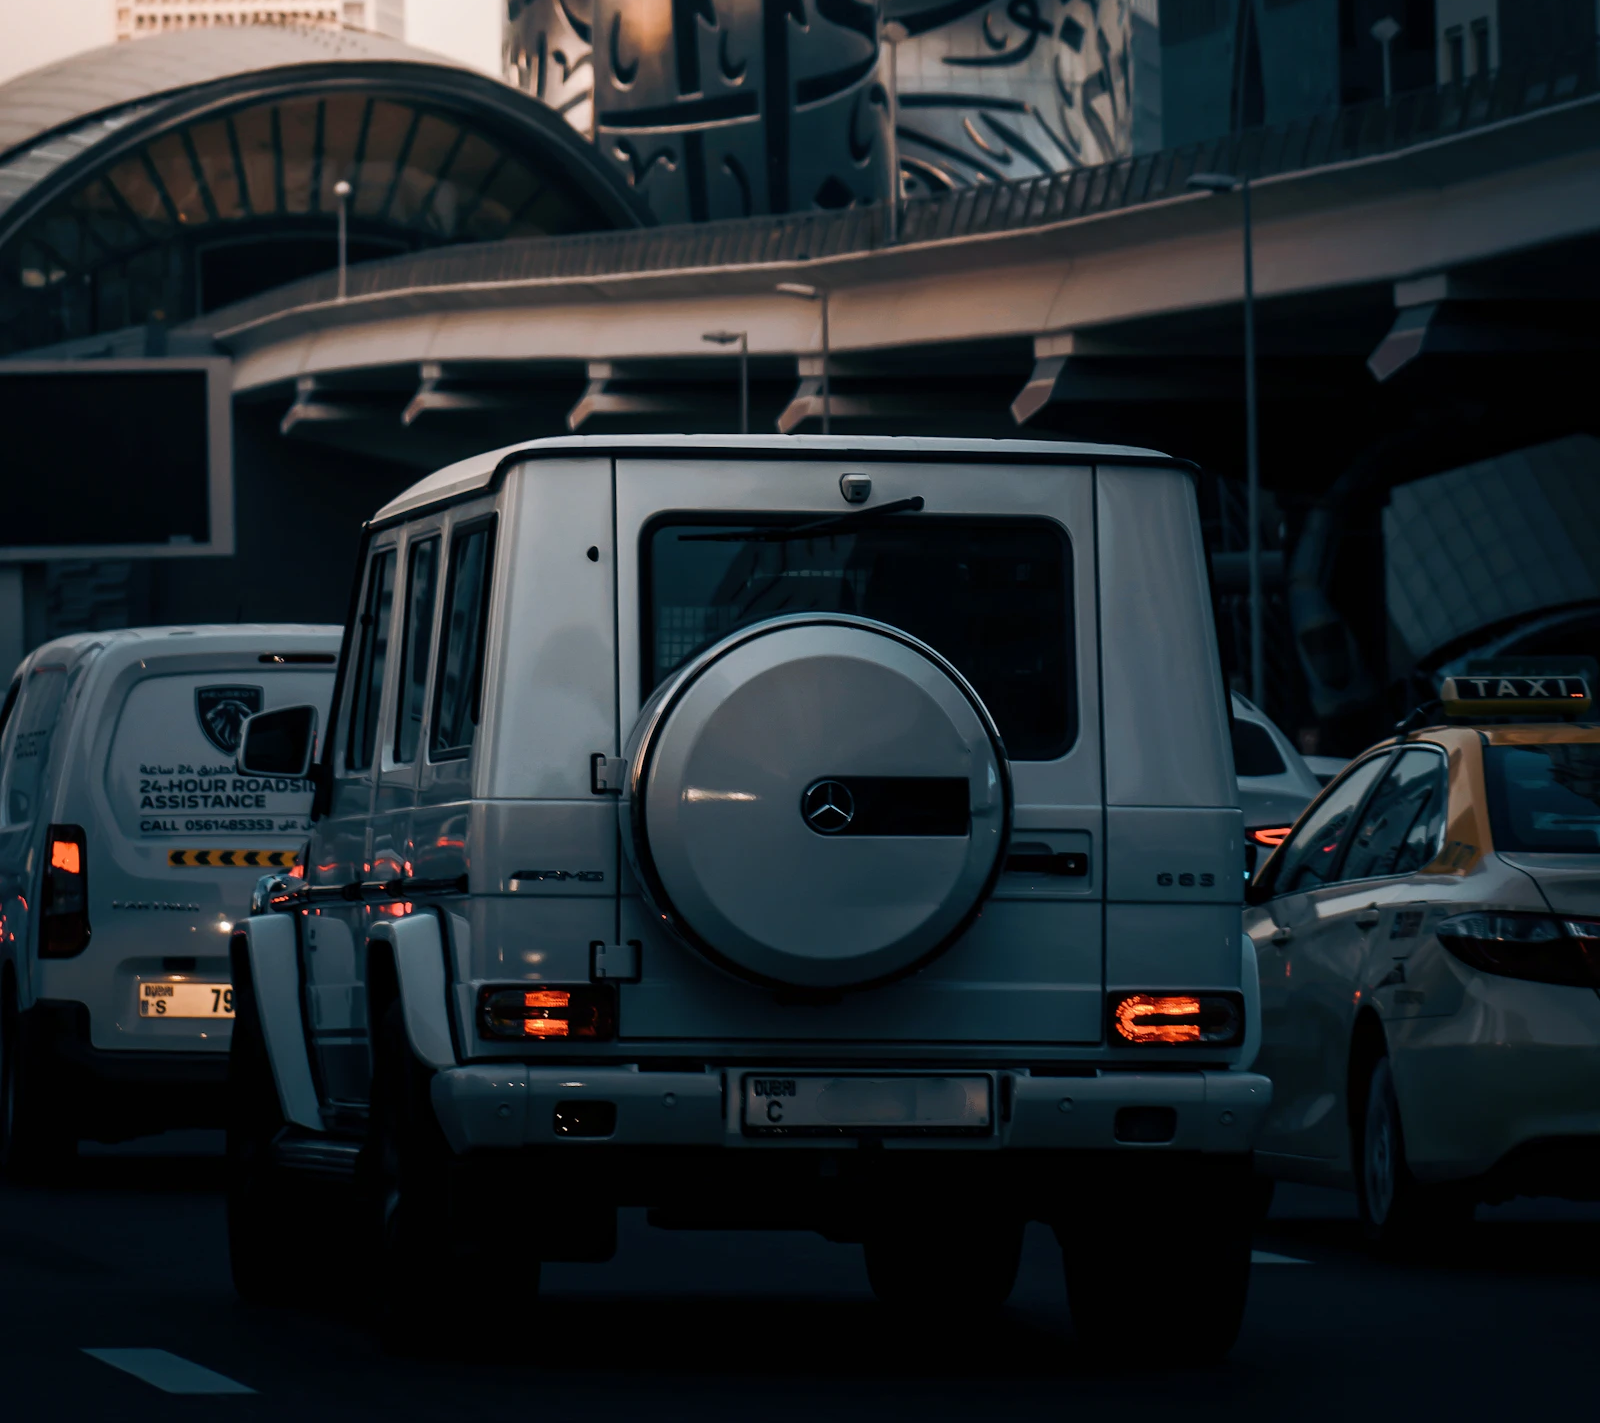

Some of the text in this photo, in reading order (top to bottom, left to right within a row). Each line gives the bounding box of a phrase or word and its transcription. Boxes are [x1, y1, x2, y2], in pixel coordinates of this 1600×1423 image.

[1469, 679, 1568, 697] TAXI
[178, 764, 194, 775] 24
[140, 779, 227, 793] 24-HOUR
[140, 794, 266, 809] ASSISTANCE
[140, 819, 273, 831] CALL 0561485353
[155, 999, 167, 1014] S
[767, 1100, 783, 1123] C
